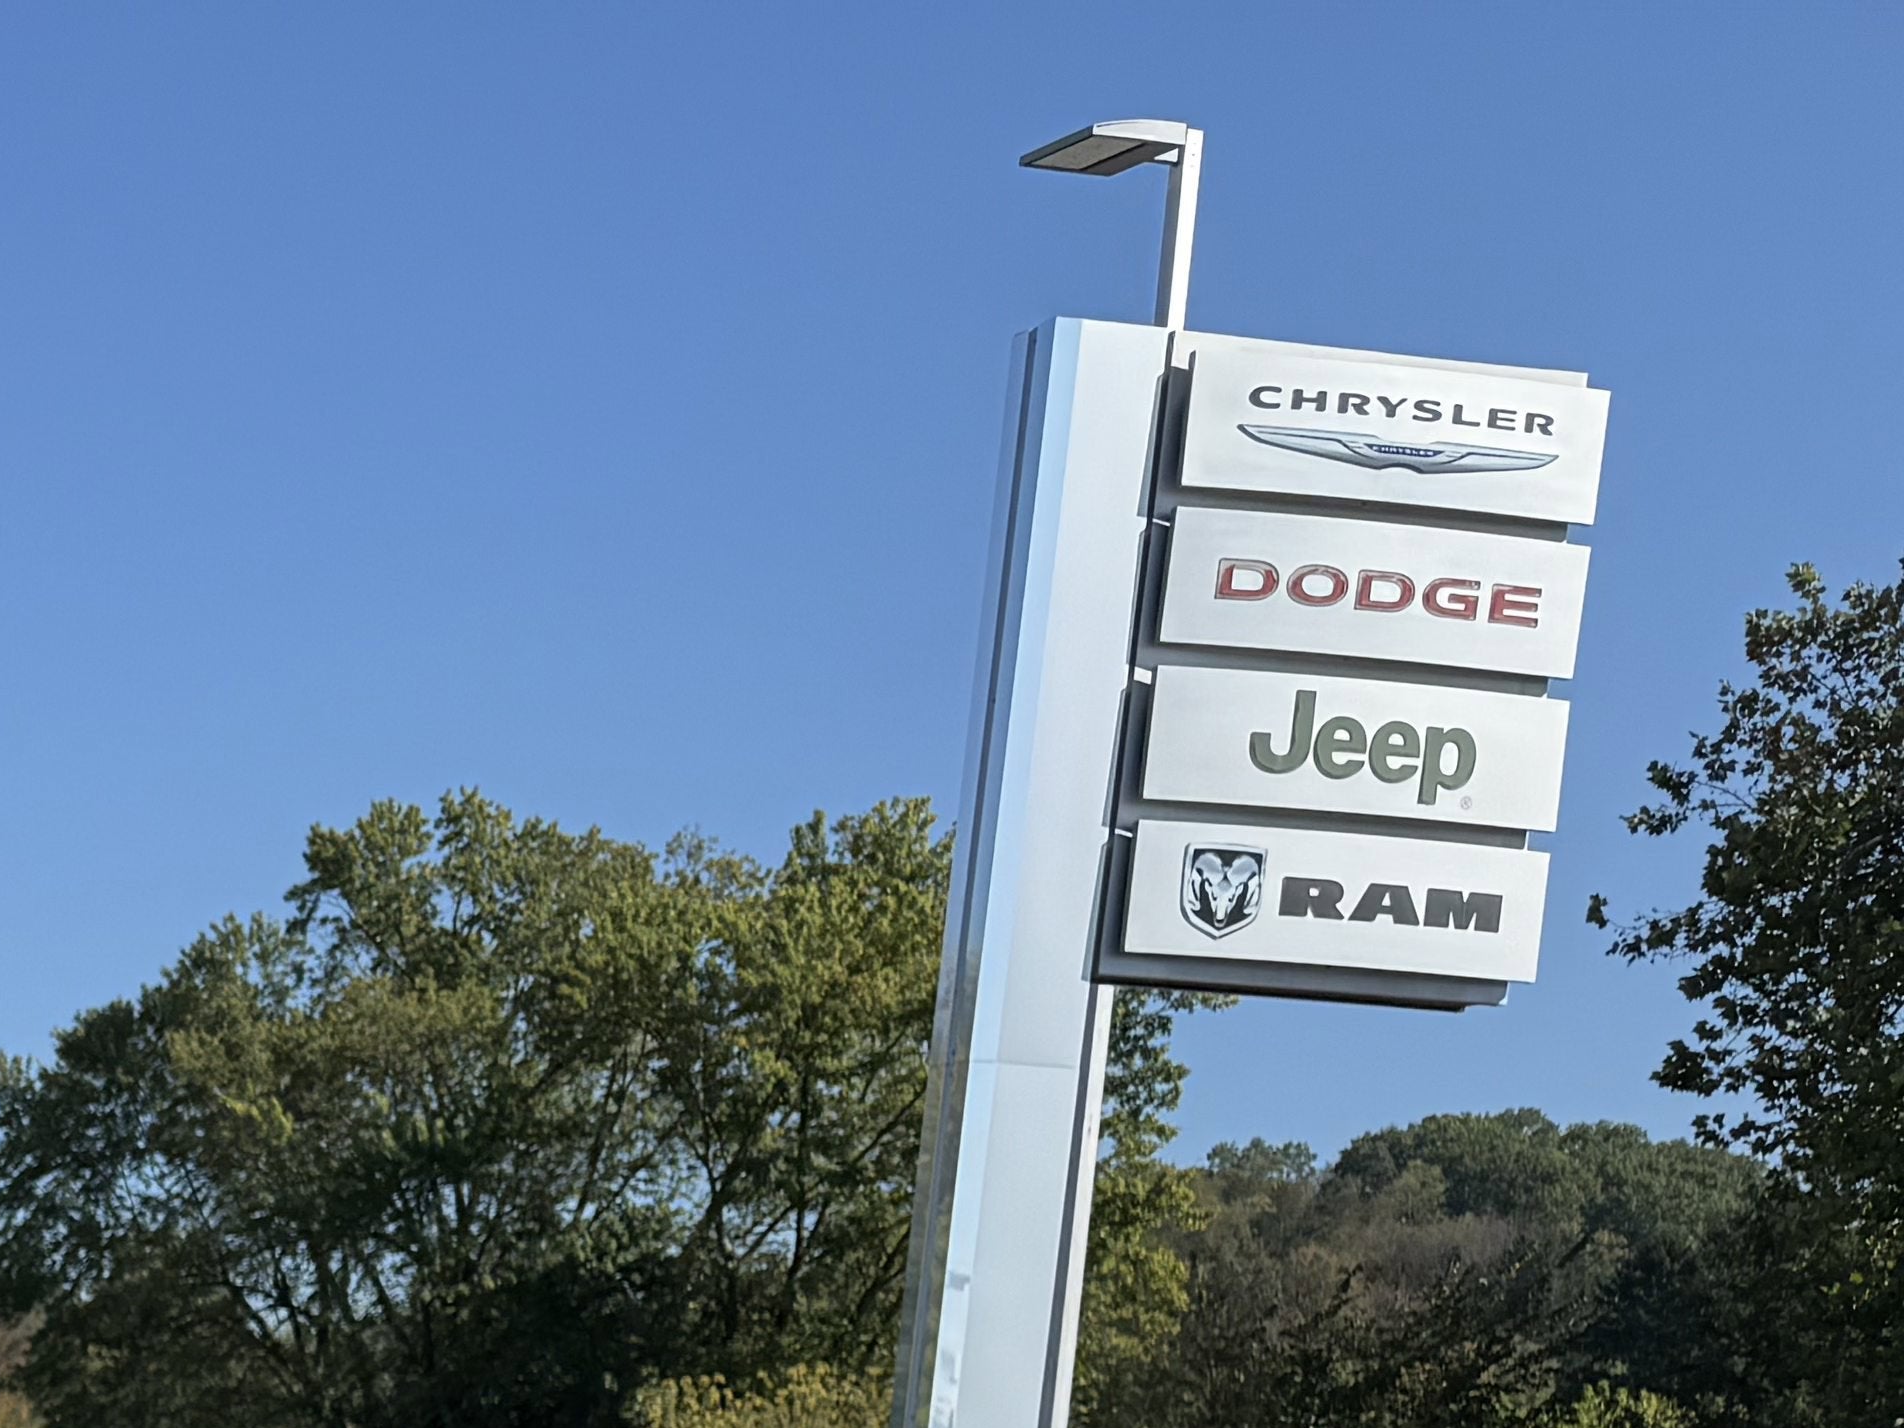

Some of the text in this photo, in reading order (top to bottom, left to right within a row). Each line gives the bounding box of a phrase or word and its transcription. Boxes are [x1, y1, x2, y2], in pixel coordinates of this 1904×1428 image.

[1248, 385, 1556, 436] CHRYSLER
[1214, 557, 1543, 629] DODGE
[1248, 690, 1477, 805] Jeep
[1278, 876, 1504, 933] RAM
